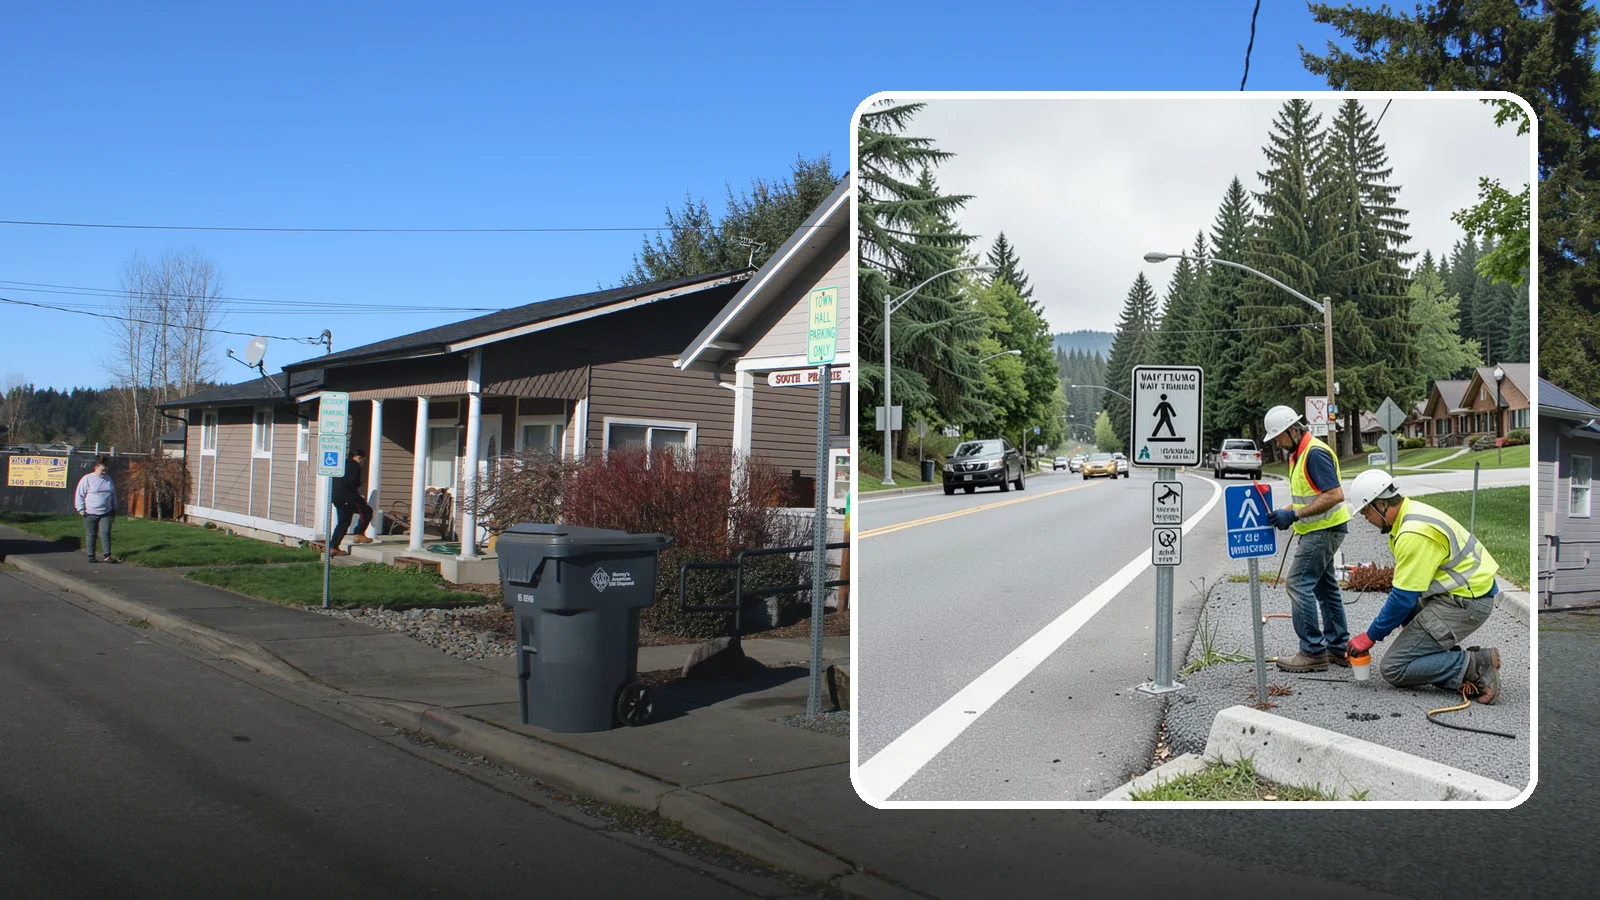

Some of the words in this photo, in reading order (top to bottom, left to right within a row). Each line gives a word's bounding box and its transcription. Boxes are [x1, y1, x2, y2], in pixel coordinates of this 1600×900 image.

[815, 294, 833, 308] TOWN
[814, 312, 831, 324] HALL
[810, 327, 836, 340] PARKING
[813, 344, 831, 357] ONLY
[775, 373, 801, 384] SOUTH
